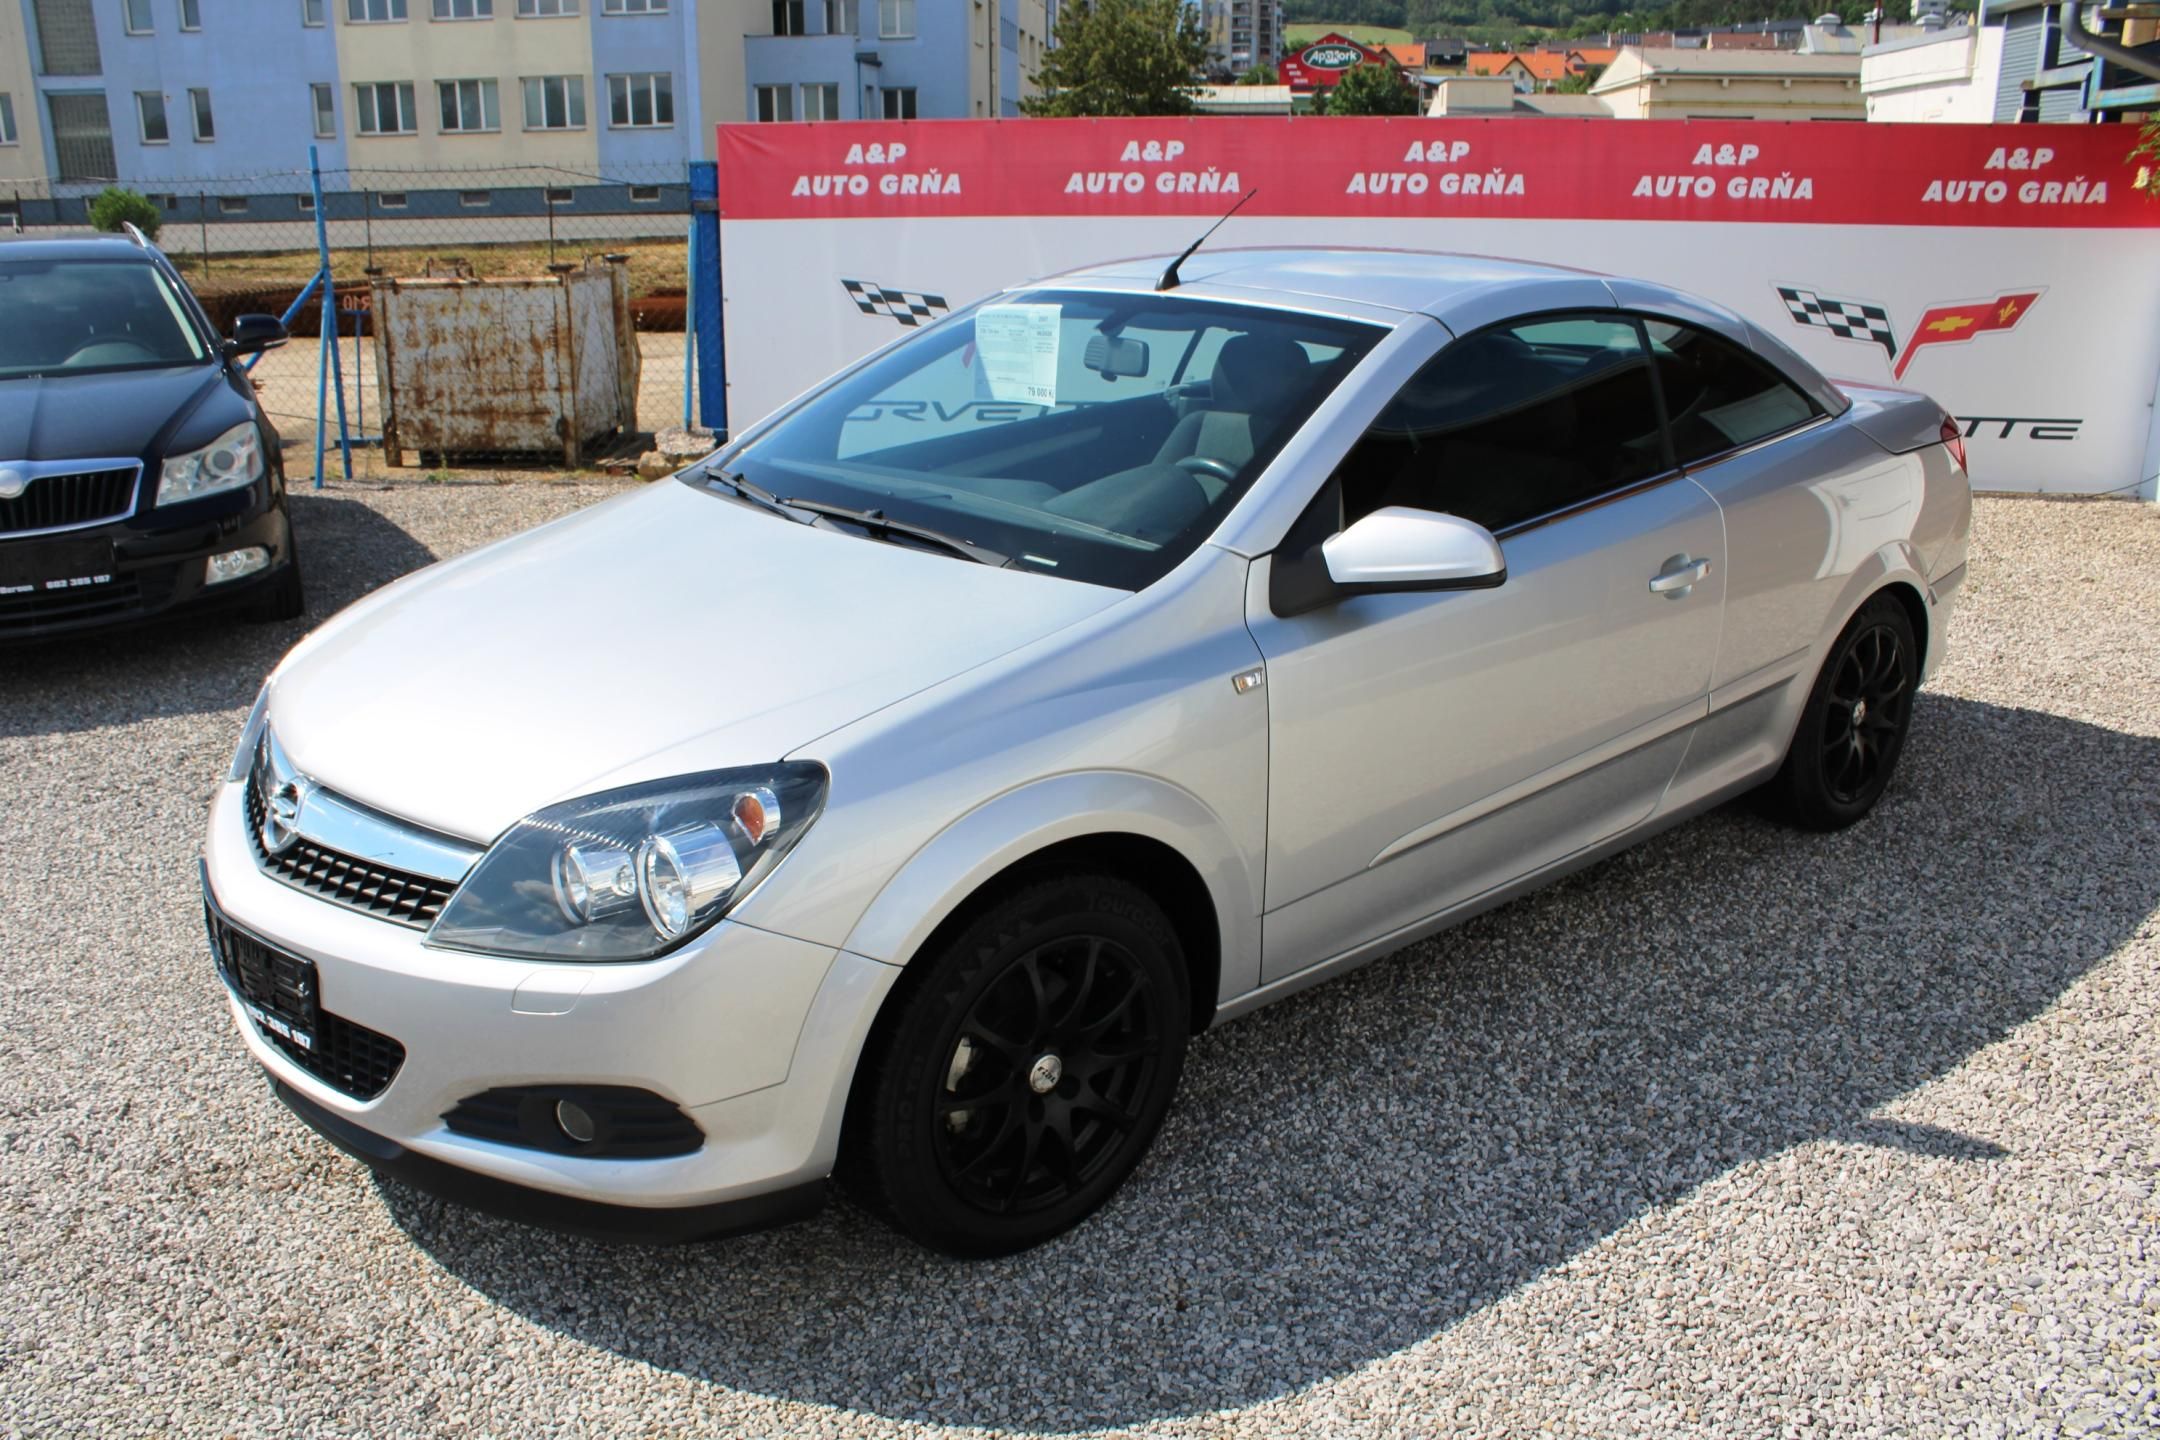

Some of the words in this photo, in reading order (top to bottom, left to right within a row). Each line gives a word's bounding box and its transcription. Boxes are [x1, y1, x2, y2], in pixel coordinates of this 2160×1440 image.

[844, 142, 907, 165] A&P
[1119, 140, 1185, 162] A&P
[1403, 140, 1471, 163] A&P
[1691, 143, 1760, 166] A&P
[1983, 147, 2055, 170] A&P
[791, 175, 869, 196] AUTO
[879, 167, 961, 195] GRŇA
[1063, 172, 1146, 194] AUTO
[1155, 166, 1241, 194] GRŇA
[1345, 172, 1429, 195] AUTO
[1439, 167, 1526, 195] GRŇA
[1631, 175, 1717, 198] AUTO
[1726, 171, 1814, 199] GRŇA
[1920, 180, 2008, 203] AUTO
[2017, 175, 2108, 204] GRŇA
